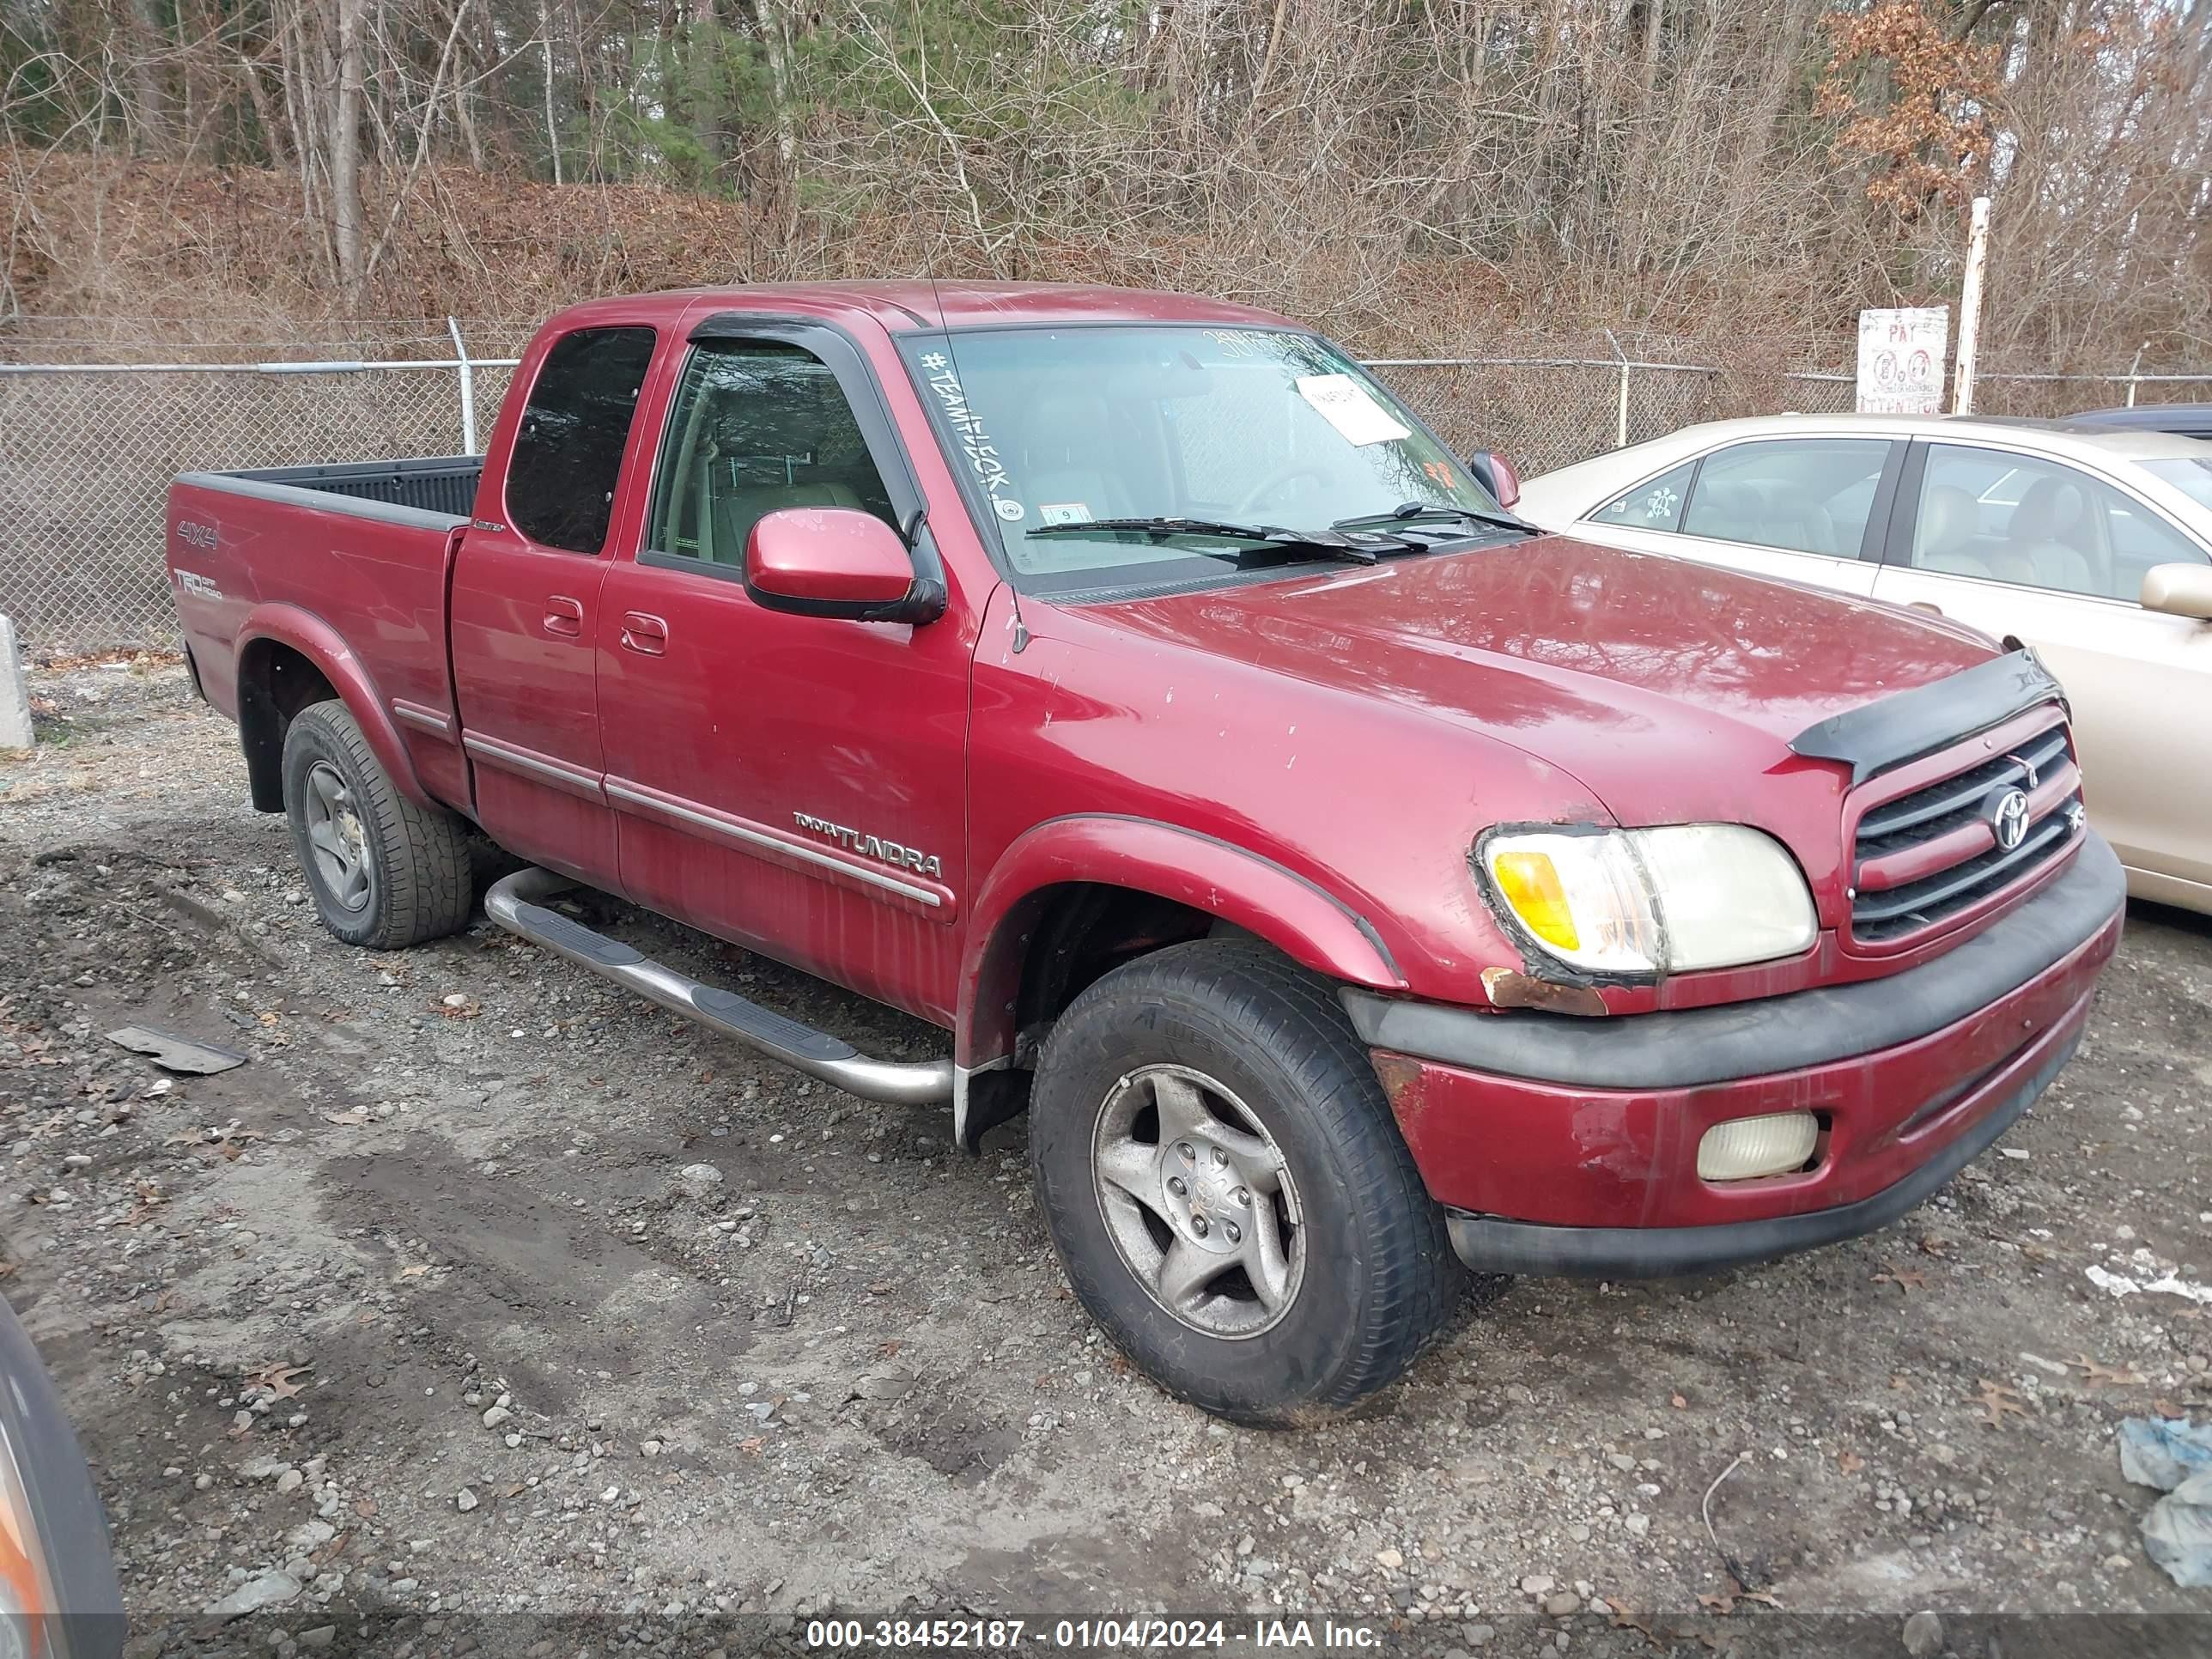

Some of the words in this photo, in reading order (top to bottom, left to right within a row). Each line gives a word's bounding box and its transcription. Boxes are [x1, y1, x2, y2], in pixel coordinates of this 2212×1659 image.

[1889, 323, 1917, 343] PAY
[173, 568, 202, 596] TRD
[203, 576, 216, 586] OFF
[204, 586, 222, 599] ROAD
[793, 811, 838, 838] TOYOTA
[836, 825, 942, 879] TUNDRA
